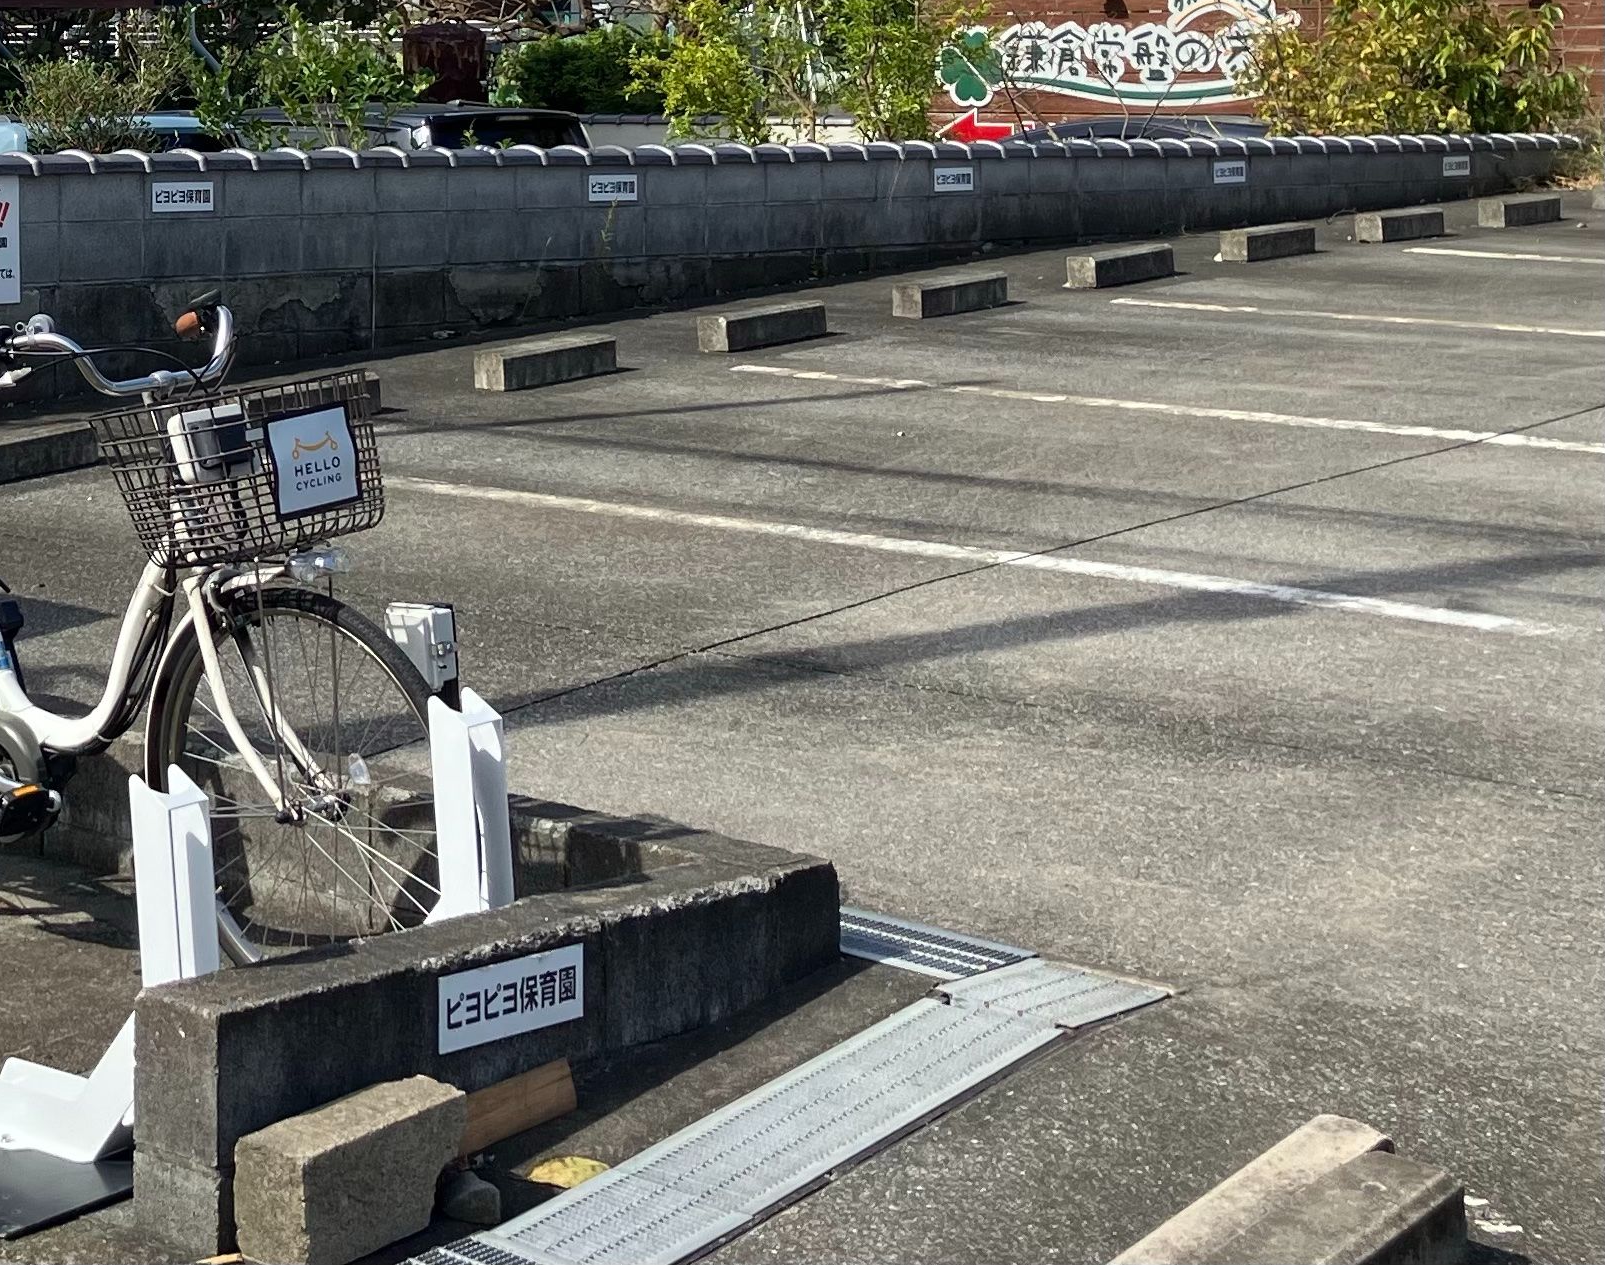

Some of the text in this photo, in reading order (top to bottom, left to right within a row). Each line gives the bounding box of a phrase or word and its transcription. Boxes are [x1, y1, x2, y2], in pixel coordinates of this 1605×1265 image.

[155, 189, 211, 204] ピヨピヨ保育園
[294, 456, 341, 477] HELLO
[295, 473, 342, 492] CYCLING
[447, 965, 576, 1029] ピヨピヨ保育園
